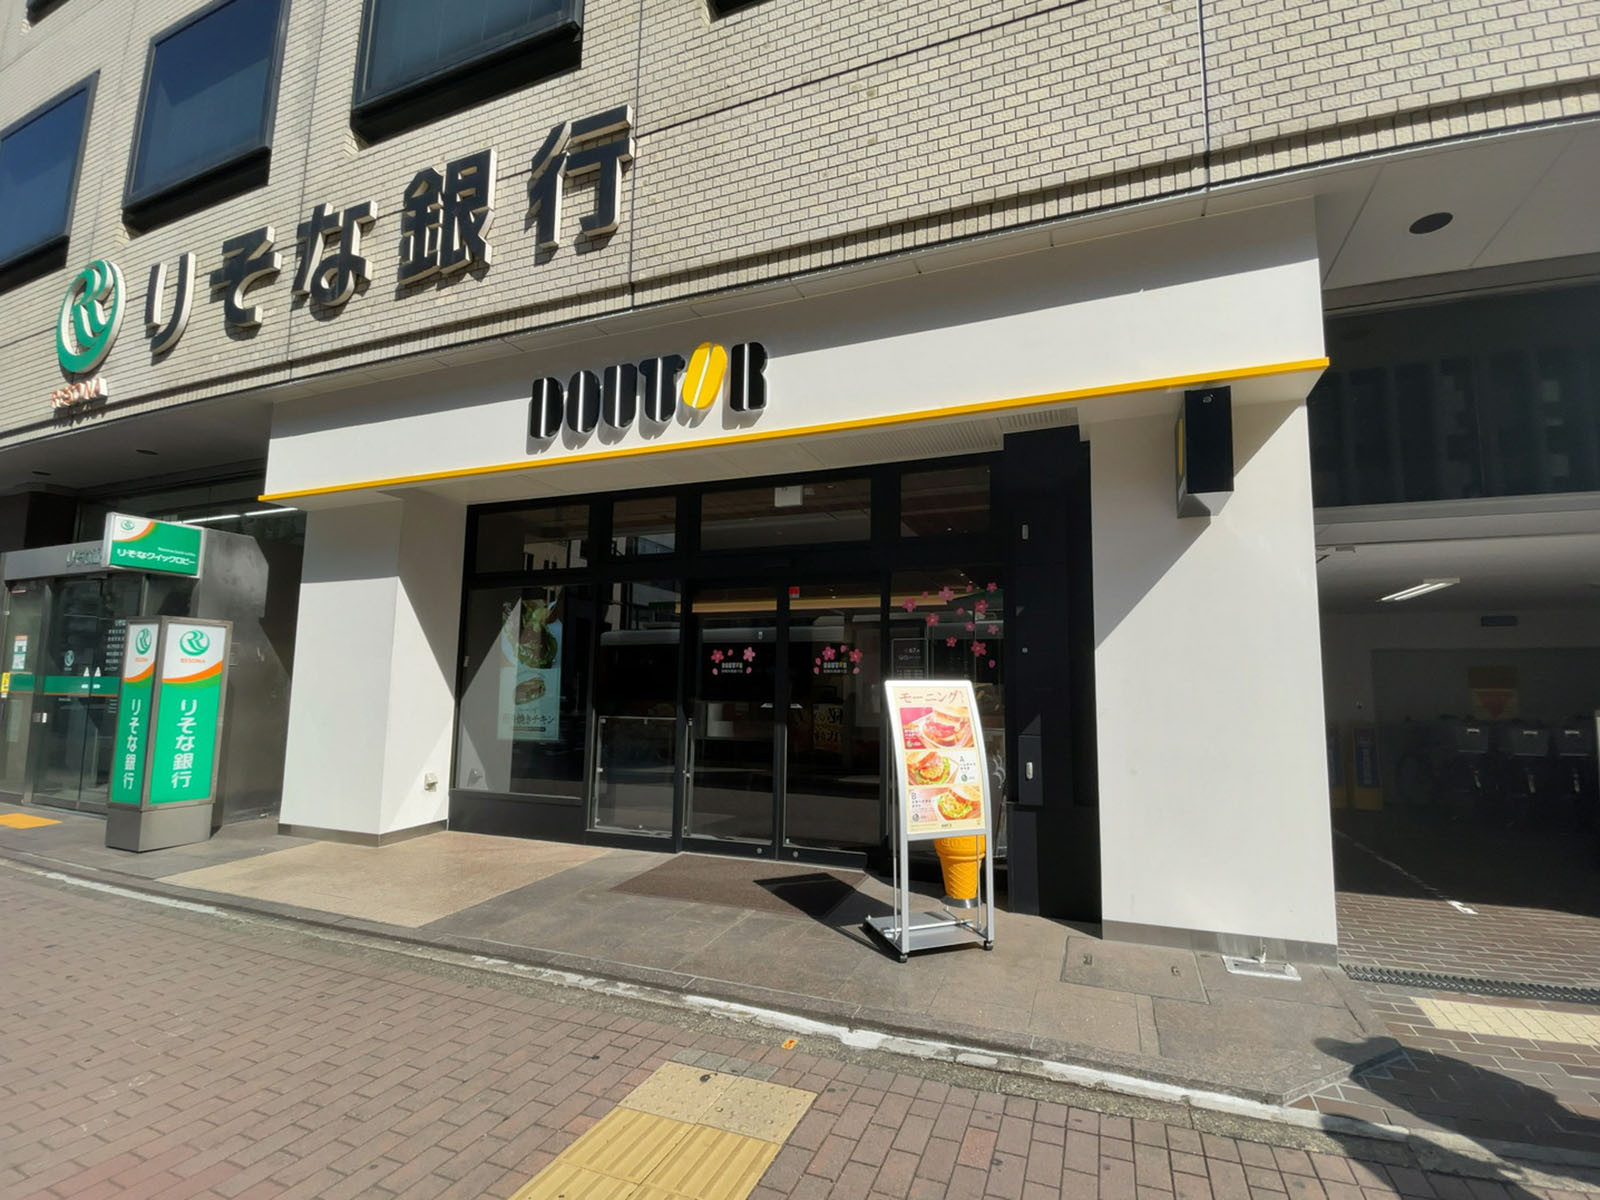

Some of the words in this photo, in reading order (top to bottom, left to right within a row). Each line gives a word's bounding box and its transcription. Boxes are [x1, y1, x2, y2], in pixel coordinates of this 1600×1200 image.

[143, 104, 634, 357] りそな銀行
[530, 342, 767, 438] DOUTOR
[116, 548, 196, 566] りそなクイックロビー
[123, 699, 141, 790] りそな銀行
[171, 699, 197, 789] りそな銀行
